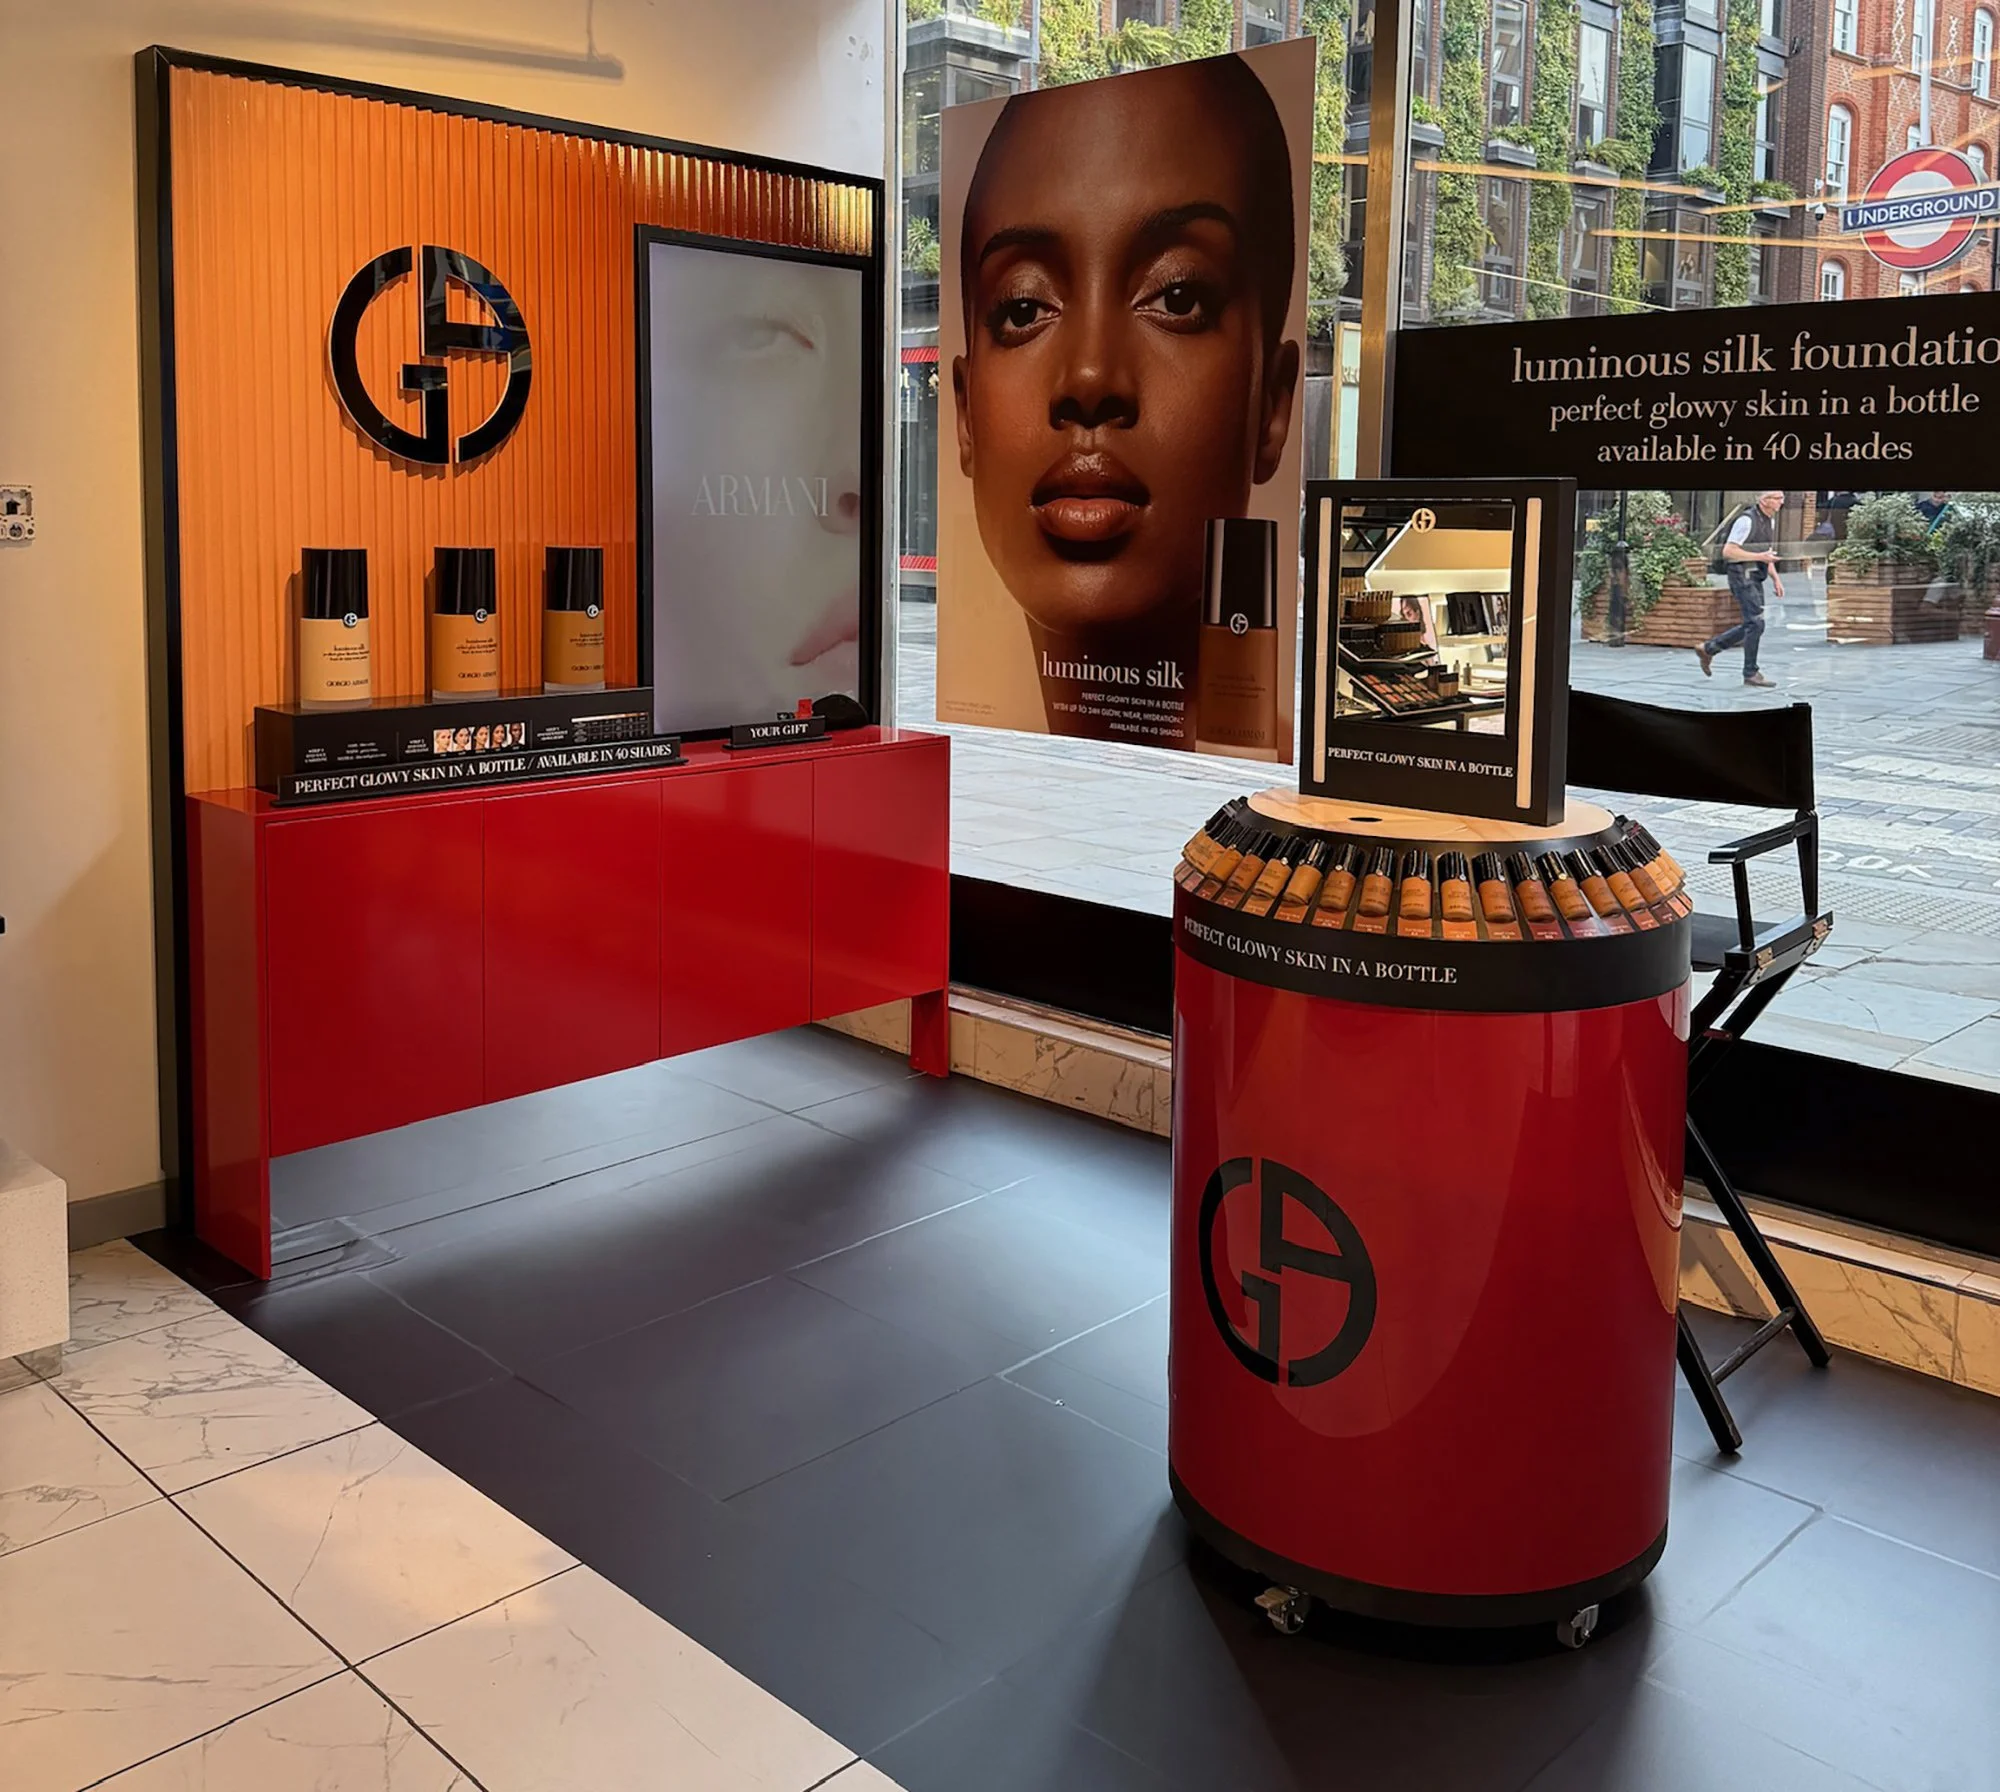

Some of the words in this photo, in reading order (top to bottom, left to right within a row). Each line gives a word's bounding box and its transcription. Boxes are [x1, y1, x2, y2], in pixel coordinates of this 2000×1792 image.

[1847, 191, 1995, 227] UNDERGROUND
[1512, 346, 1690, 383] luminous
[1702, 333, 1776, 375] silk
[1549, 394, 1642, 432] perfect
[1650, 391, 1738, 429] glowy
[1745, 389, 1809, 418] skin
[1820, 389, 1849, 416] in
[1859, 396, 1877, 415] a
[1887, 383, 1980, 414] bottle
[1597, 434, 1716, 463] available
[1724, 436, 1754, 461] in
[1763, 432, 1800, 461] 40
[1809, 432, 1913, 461] shades
[690, 474, 829, 517] ARMANI
[1041, 651, 1140, 685] luminous
[1146, 660, 1184, 689] silk
[1069, 703, 1078, 712] UP
[1078, 703, 1087, 714] TO
[1081, 692, 1105, 702] PERFECT
[1155, 699, 1161, 708] A
[1162, 700, 1185, 711] BOTTLE
[750, 726, 780, 738] YOUR
[782, 723, 808, 735] GIFT
[1109, 722, 1140, 733] AVAILABLE
[1159, 727, 1185, 738] SHADES
[294, 774, 358, 794] PERFECT
[360, 769, 411, 788] GLOWY
[412, 767, 446, 781] SKIN
[448, 764, 462, 778] IN
[466, 763, 475, 776] A
[479, 757, 526, 774] BOTTLE
[527, 757, 534, 769] /
[536, 750, 599, 769] AVAILABLE
[601, 748, 613, 761] IN
[615, 747, 628, 760] 40
[630, 743, 672, 758] SHADES
[1327, 747, 1374, 762] PERFECT
[1375, 752, 1415, 767] GLOWY
[1417, 756, 1443, 770] SKIN
[1445, 760, 1457, 771] IN
[1458, 762, 1467, 772] A
[1468, 762, 1514, 778] BOTTLE
[1184, 915, 1225, 947] PERFECT
[1227, 934, 1282, 962] GLOWY
[1285, 950, 1327, 971] SKIN
[1332, 957, 1352, 975] IN
[1356, 961, 1370, 977] A
[1375, 962, 1458, 984] BOTTLE
